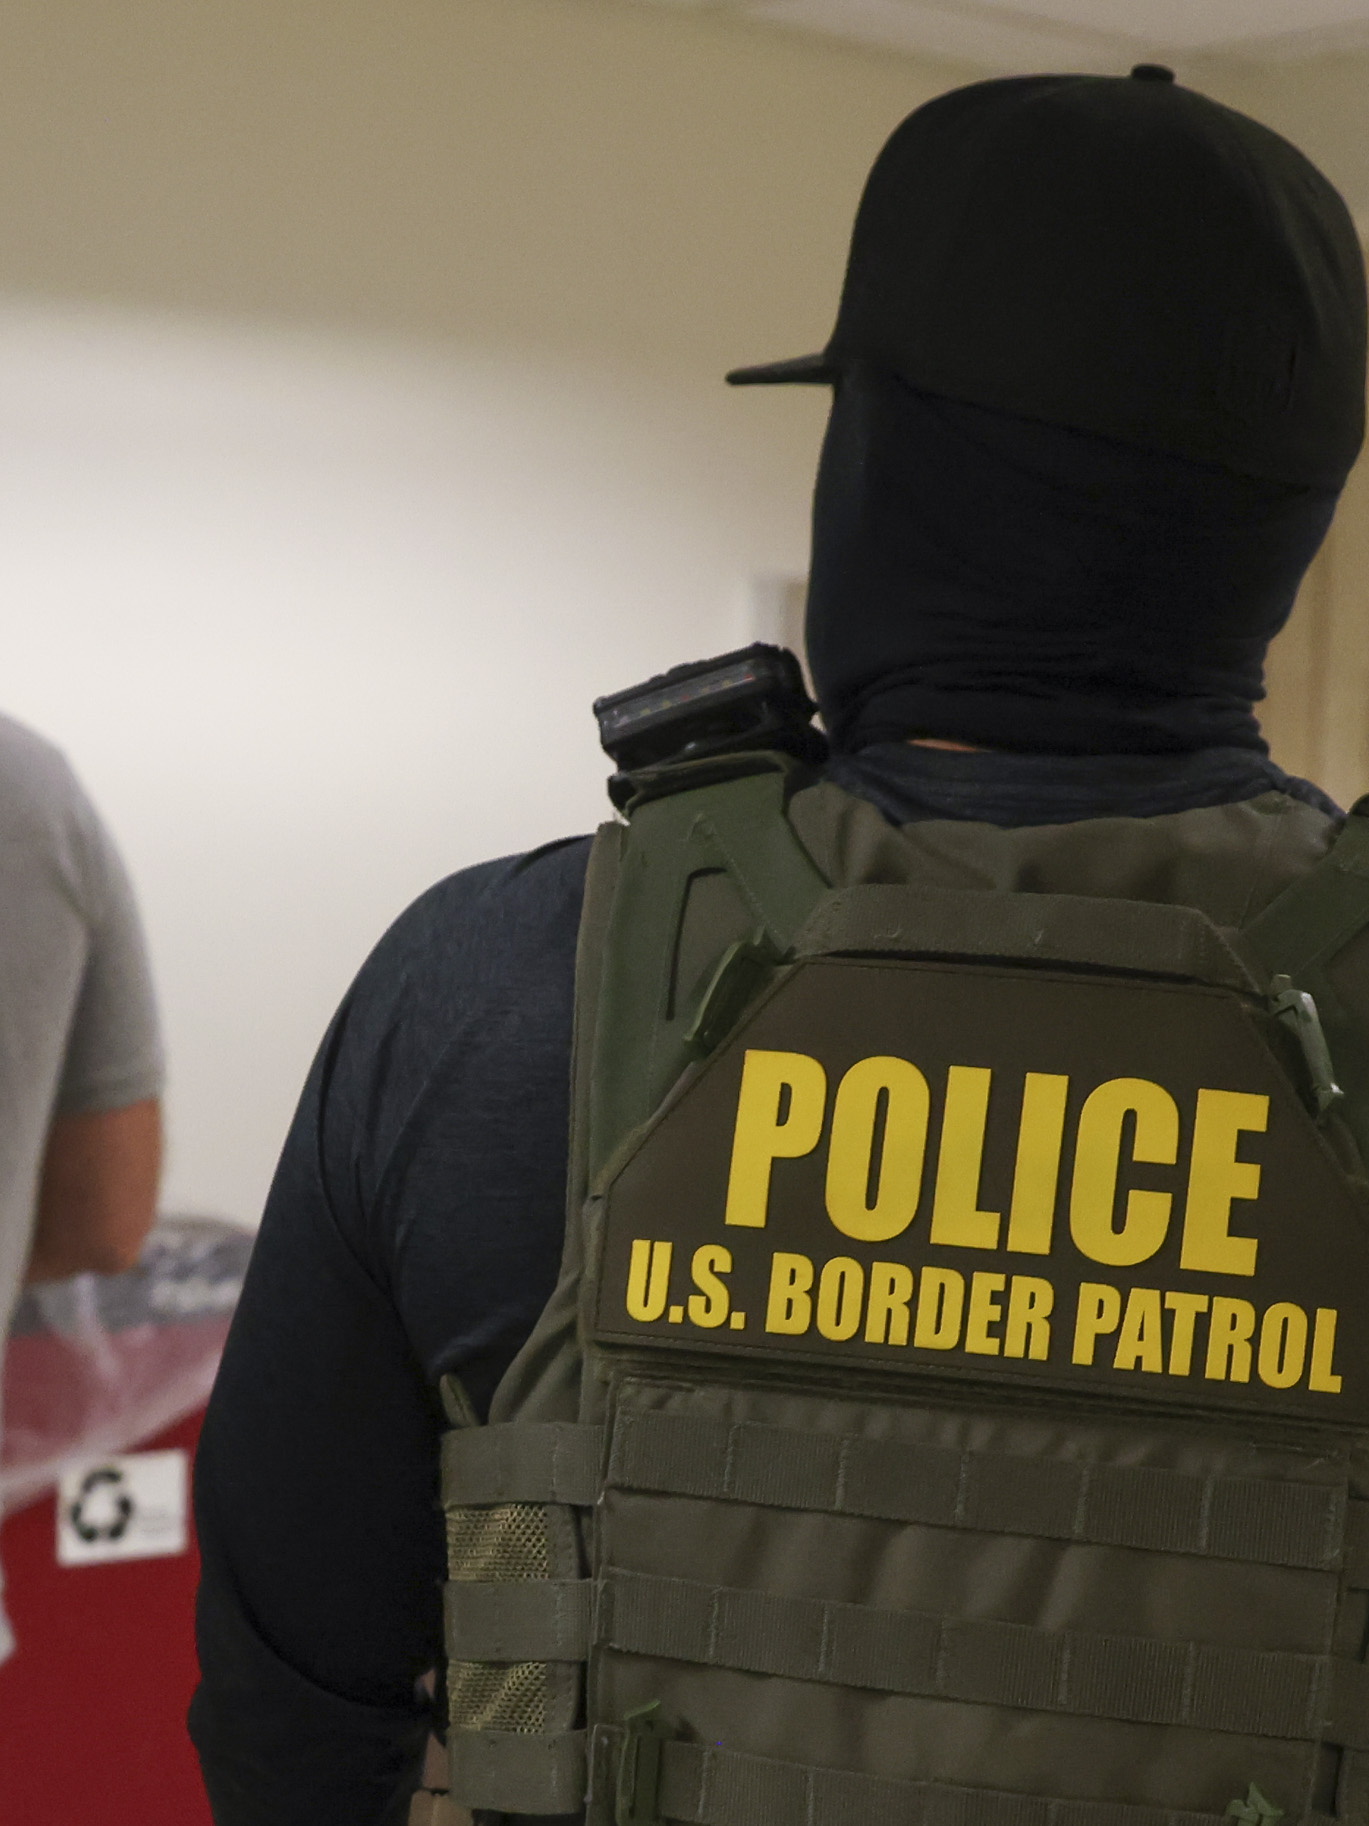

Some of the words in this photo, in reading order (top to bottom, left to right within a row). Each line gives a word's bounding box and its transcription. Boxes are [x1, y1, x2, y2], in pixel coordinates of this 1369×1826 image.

[725, 1049, 1270, 1277] POLICE
[626, 1239, 746, 1330] U.S.
[765, 1252, 1054, 1361] BORDER
[1072, 1282, 1343, 1393] PATROL
